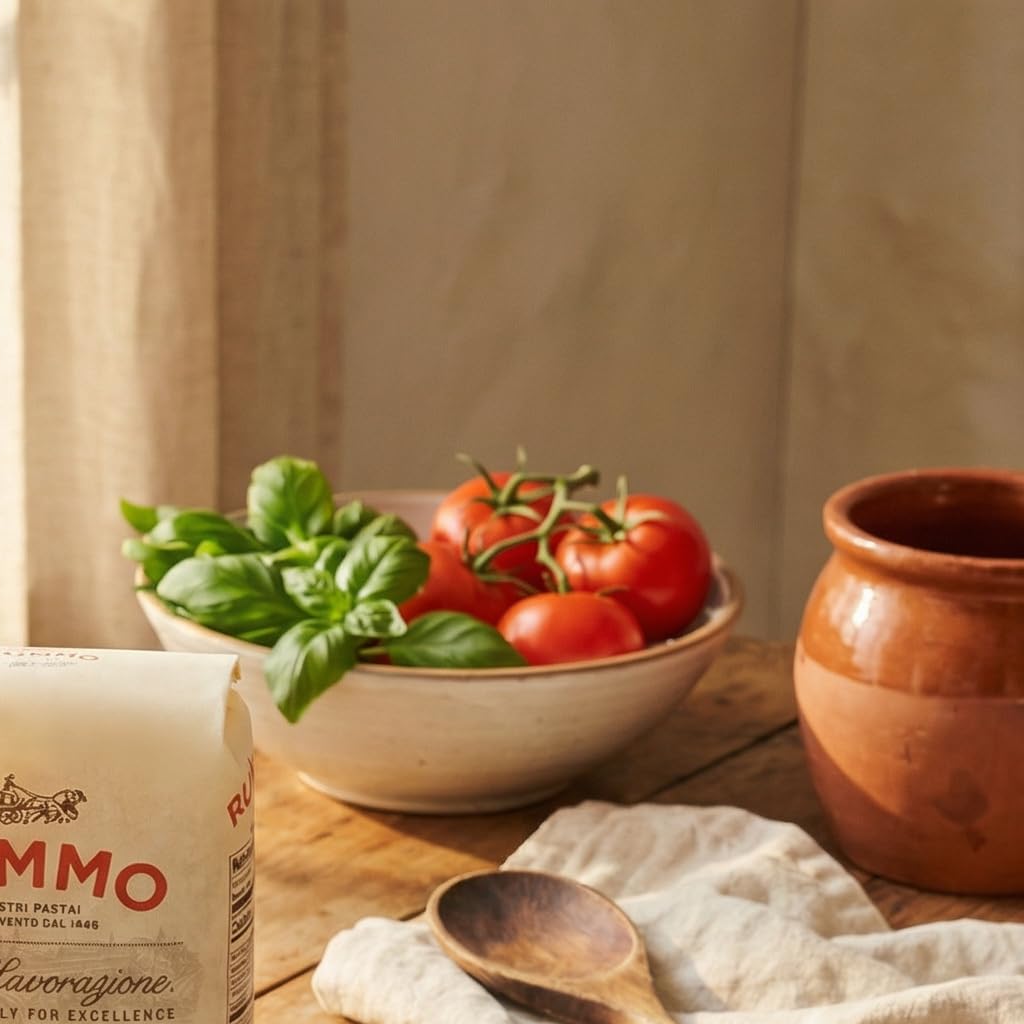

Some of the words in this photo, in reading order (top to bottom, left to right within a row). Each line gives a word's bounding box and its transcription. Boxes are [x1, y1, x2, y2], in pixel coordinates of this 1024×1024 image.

[227, 756, 254, 828] RU
[33, 903, 81, 915] PASTAI
[28, 1008, 59, 1021] FOR
[67, 1007, 176, 1022] EXCELLENCE
